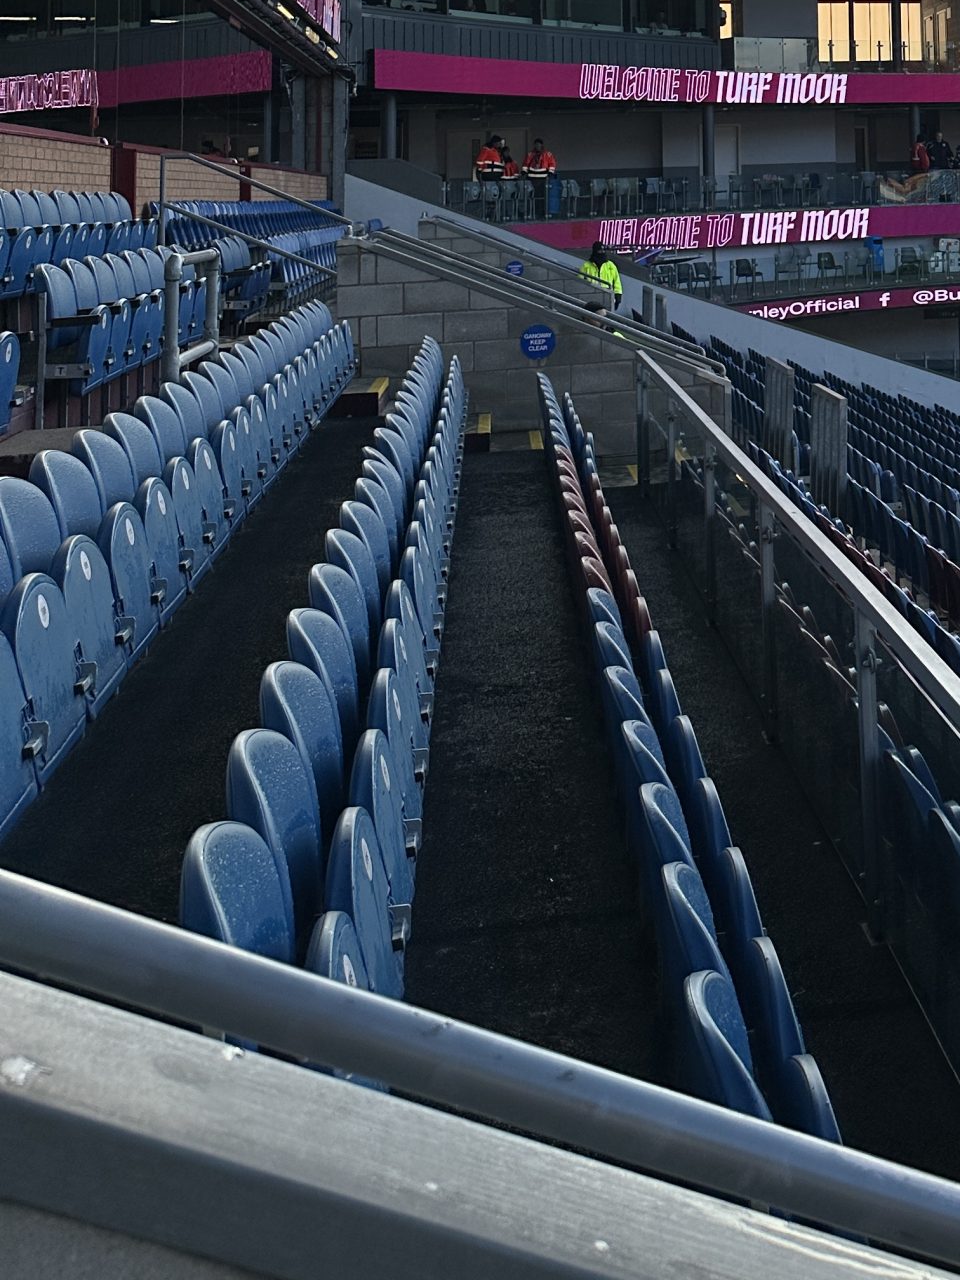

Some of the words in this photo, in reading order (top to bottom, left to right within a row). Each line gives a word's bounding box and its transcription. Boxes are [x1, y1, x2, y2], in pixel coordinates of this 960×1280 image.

[579, 63, 680, 101] WELCOME
[685, 69, 711, 103] TO
[715, 71, 770, 104] TURF
[776, 72, 848, 104] MOOR
[599, 215, 700, 254] WELCOME
[706, 214, 735, 248] TO
[740, 211, 797, 246] TURF
[800, 208, 870, 242] MOOR
[748, 296, 860, 320] nleyOfficial
[523, 332, 552, 340] GANGWAY
